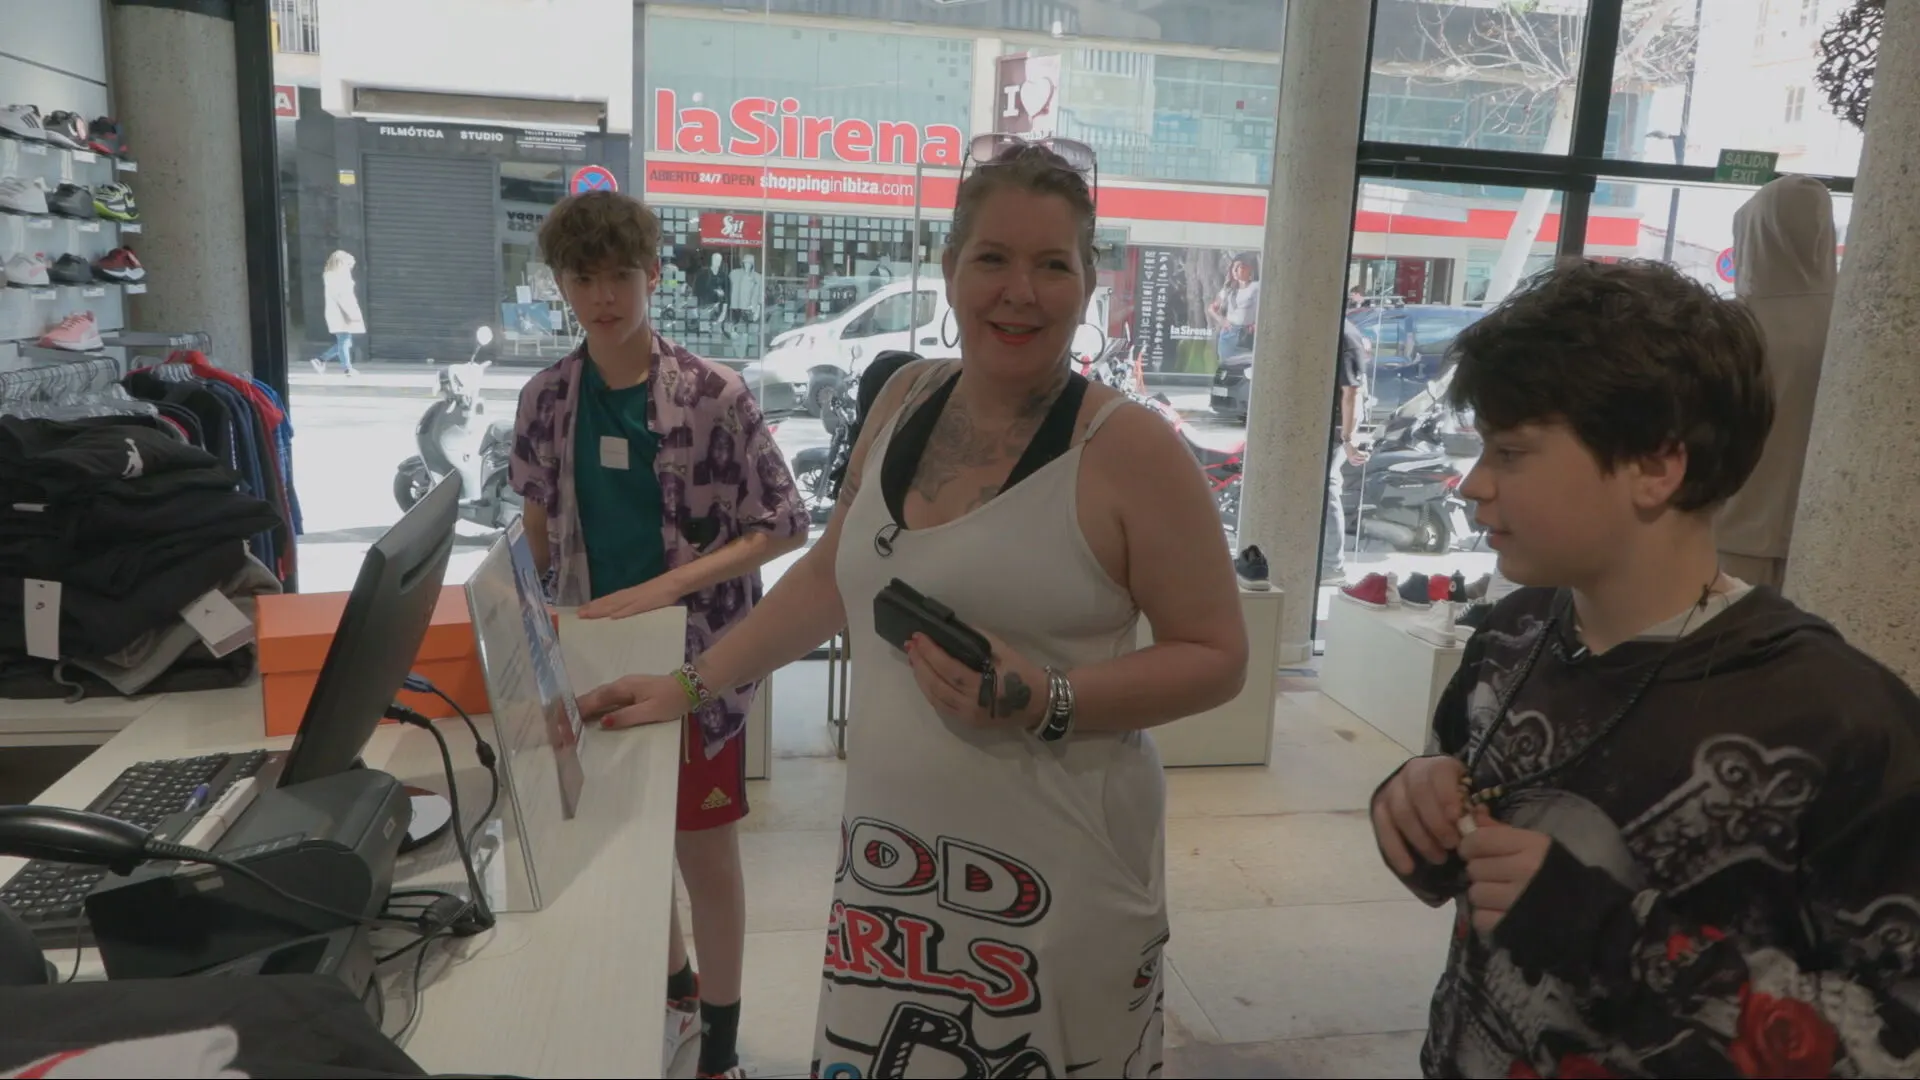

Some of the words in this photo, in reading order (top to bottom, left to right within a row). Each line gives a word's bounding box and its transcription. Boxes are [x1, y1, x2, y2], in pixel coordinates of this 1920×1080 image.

[379, 126, 444, 139] FILMÓTICA
[460, 130, 504, 142] STUDIO
[1725, 152, 1769, 168] SALIDA
[1731, 168, 1759, 184] EXIT
